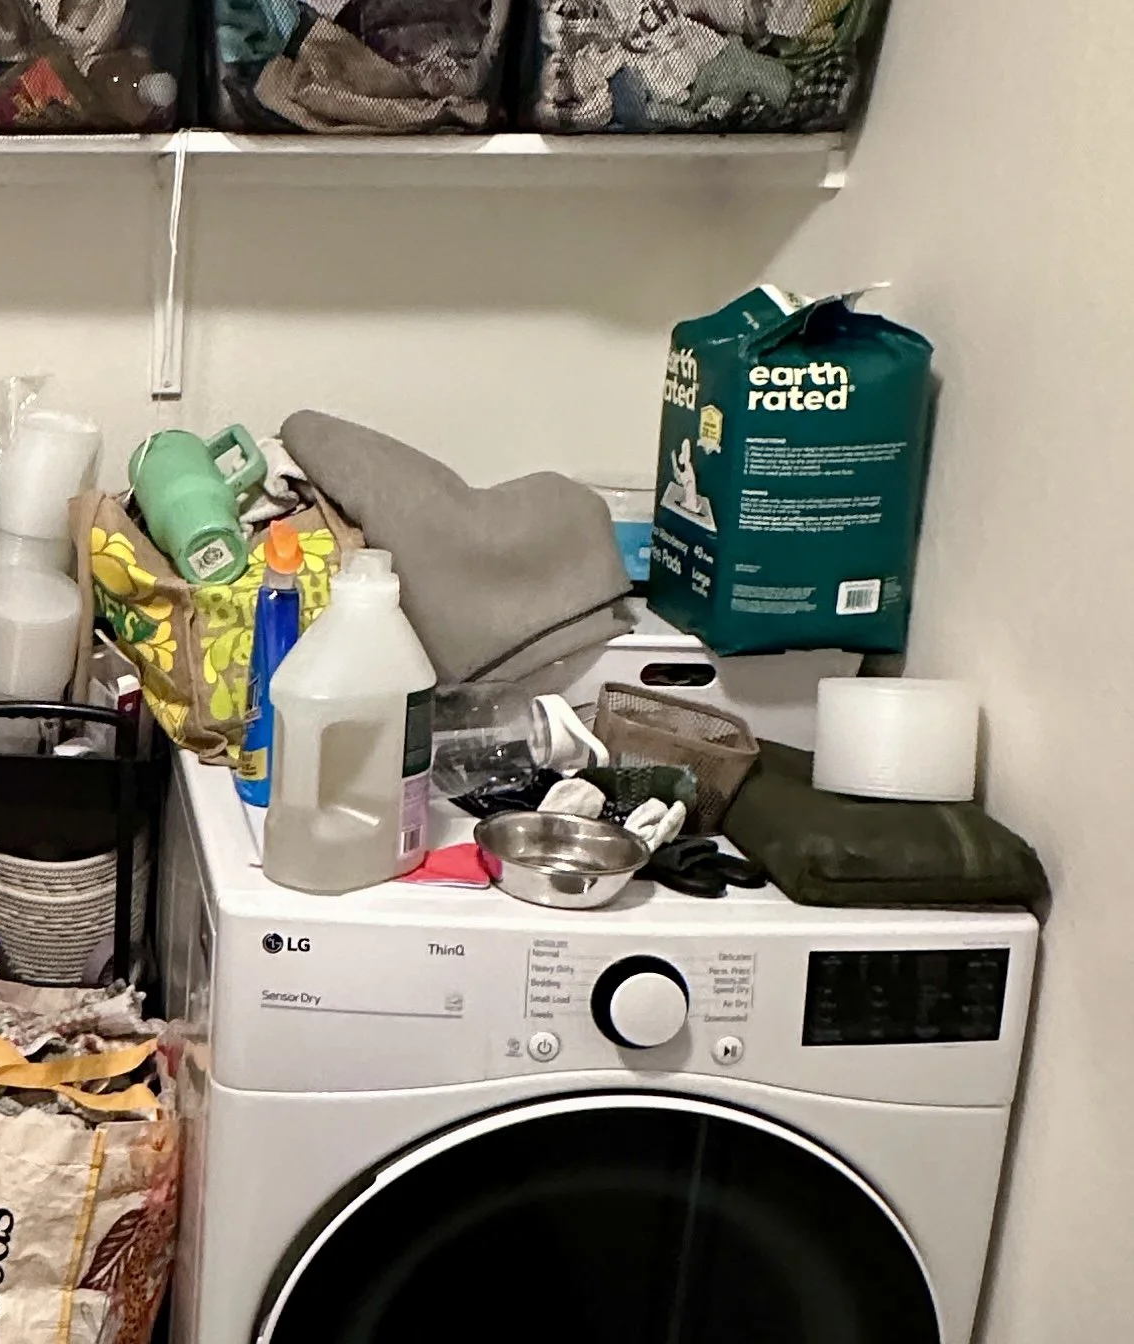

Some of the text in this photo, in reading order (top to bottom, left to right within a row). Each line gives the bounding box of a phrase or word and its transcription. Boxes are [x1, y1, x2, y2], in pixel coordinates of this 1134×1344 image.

[748, 361, 849, 387] earth
[664, 376, 697, 412] ated
[747, 384, 849, 412] rated
[286, 936, 312, 953] LG
[427, 942, 466, 957] ThinQ
